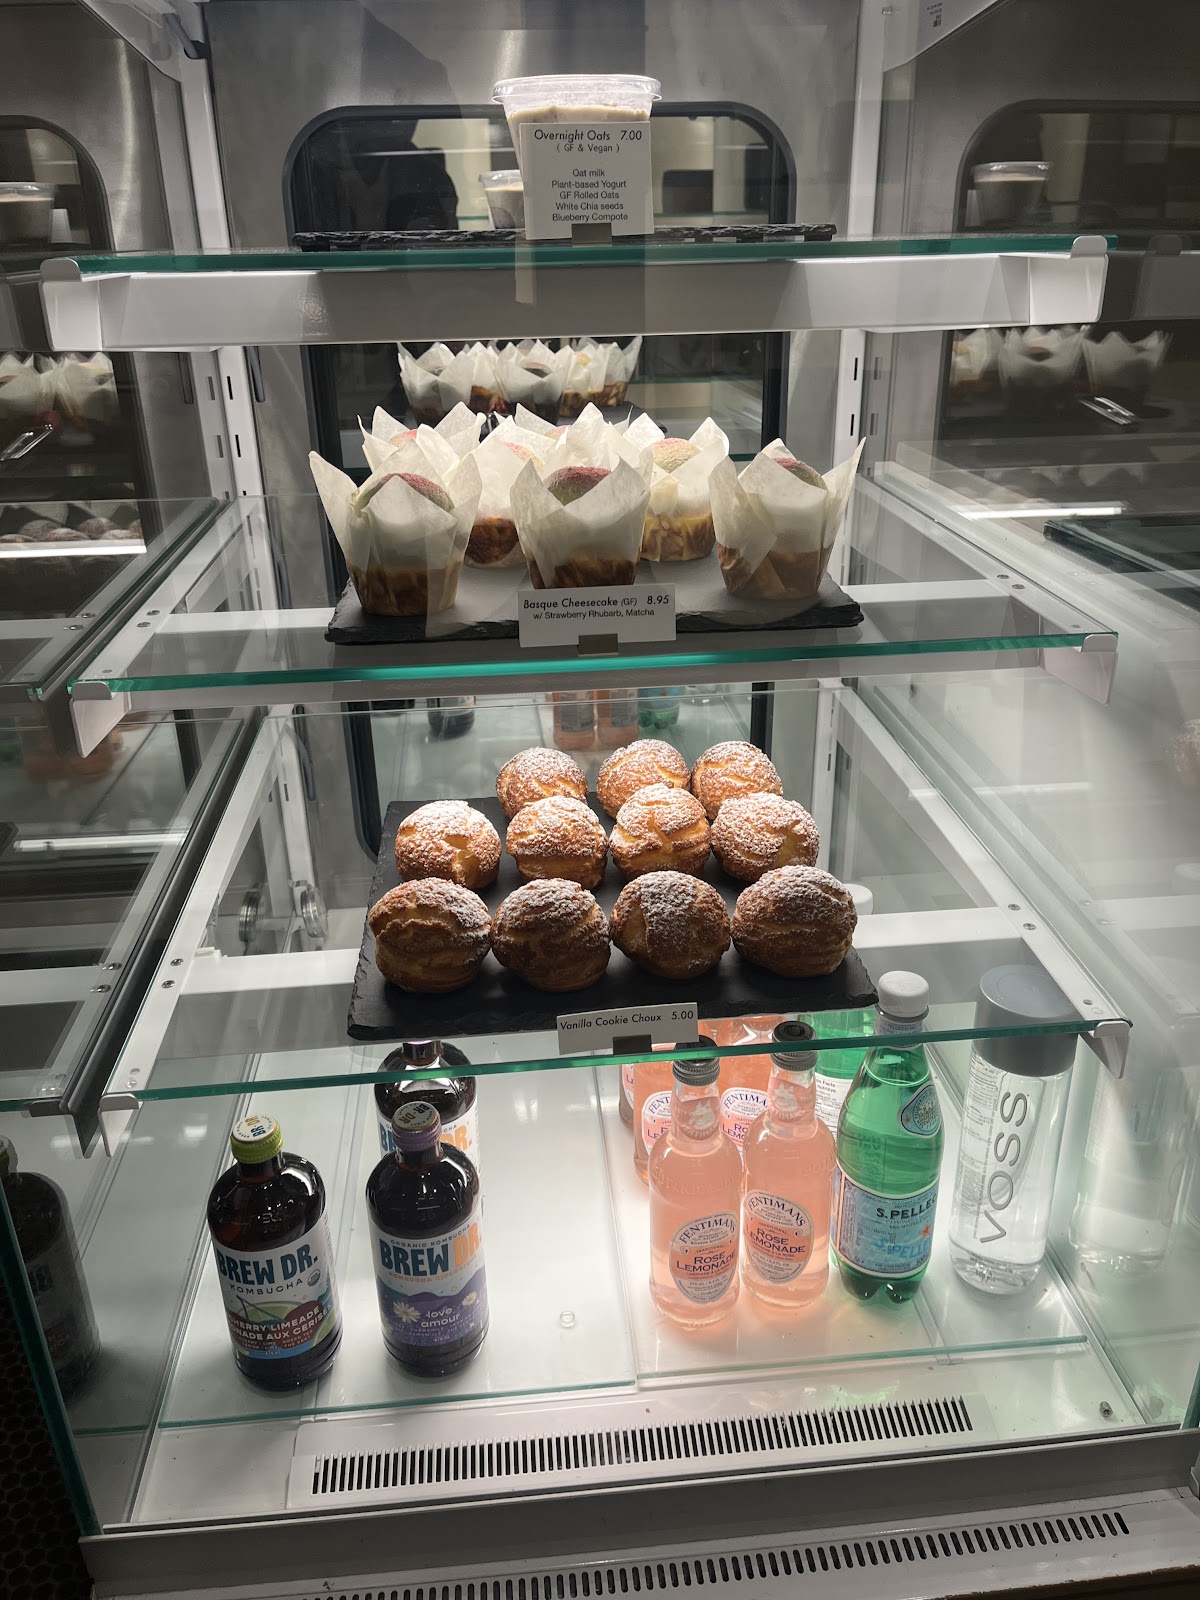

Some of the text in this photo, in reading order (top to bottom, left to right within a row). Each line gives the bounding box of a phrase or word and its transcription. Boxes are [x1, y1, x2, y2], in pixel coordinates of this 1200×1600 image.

[534, 129, 642, 142] Overnight Oats 7.00
[588, 144, 612, 154] Vegan
[572, 168, 606, 177] Oat milk
[552, 180, 626, 190] Plant-based Yogurt
[574, 191, 599, 199] Rolled
[600, 191, 620, 199] Oats
[580, 202, 599, 210] Chia
[600, 202, 624, 210] seeds
[552, 213, 628, 222] Blueberry Compote
[523, 595, 670, 611] Basque Cheesecake (GF) 8.95
[545, 610, 587, 620] Strawberry
[588, 610, 624, 618] Rhubarb,
[626, 608, 655, 617] Matcha
[560, 1010, 694, 1030] Vanilla Cookie Choux 5.00
[979, 1091, 1028, 1243] VOSS
[748, 1196, 806, 1227] FENTIMANS
[390, 1224, 470, 1248] ORGANIC KOMBUCHA
[757, 1228, 789, 1246] ROSE
[379, 1222, 482, 1276] BREW DR.
[216, 1244, 318, 1286] BREW DR.
[676, 1250, 736, 1272] LEMONADE
[694, 1251, 726, 1265] ROSE
[230, 1278, 303, 1295] KOMBUCHA
[270, 1306, 320, 1331] LIMEADE
[421, 1313, 461, 1328] amour
[266, 1331, 290, 1340] AUX
